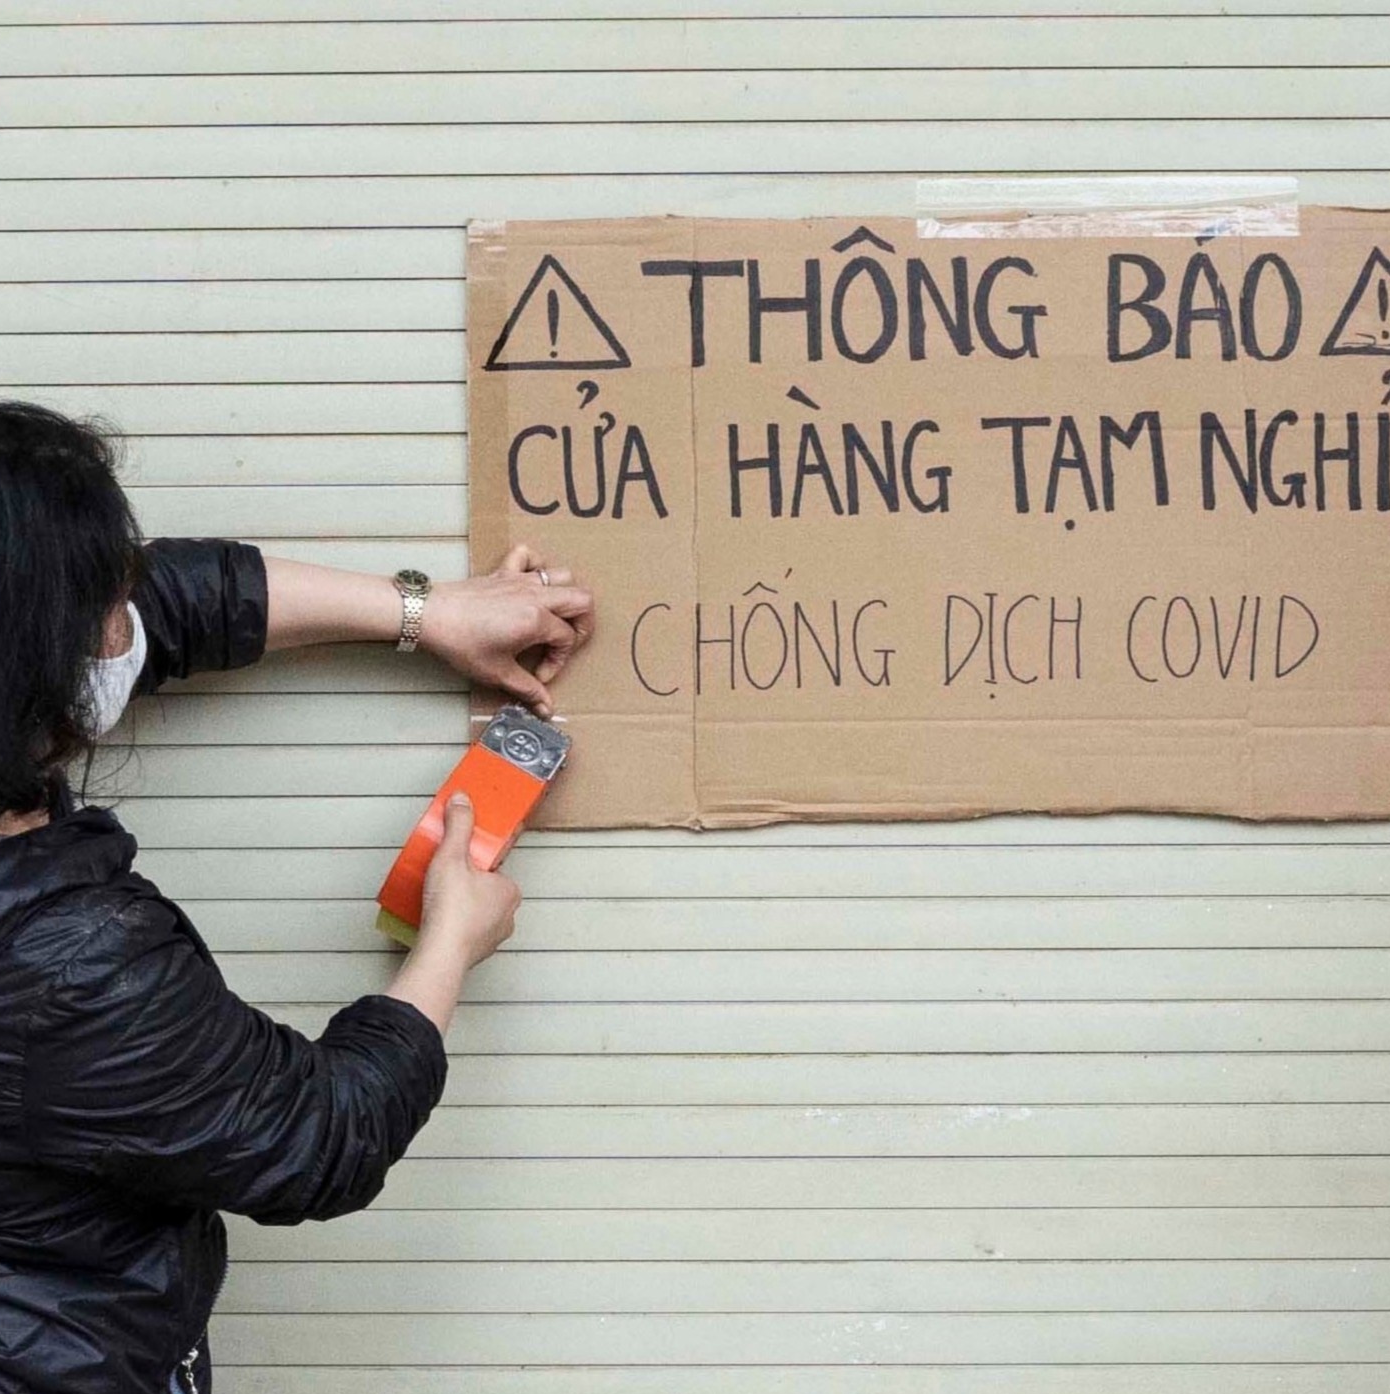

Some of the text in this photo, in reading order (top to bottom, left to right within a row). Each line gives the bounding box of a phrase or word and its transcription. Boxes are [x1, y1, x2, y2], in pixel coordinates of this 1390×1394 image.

[641, 226, 1302, 366] THÔNG BÁO
[507, 381, 668, 519] CỬA
[728, 386, 952, 518] HÀNG
[980, 411, 1171, 531] TẠM
[631, 568, 1320, 699] CHỐNG DỊCH COVID
